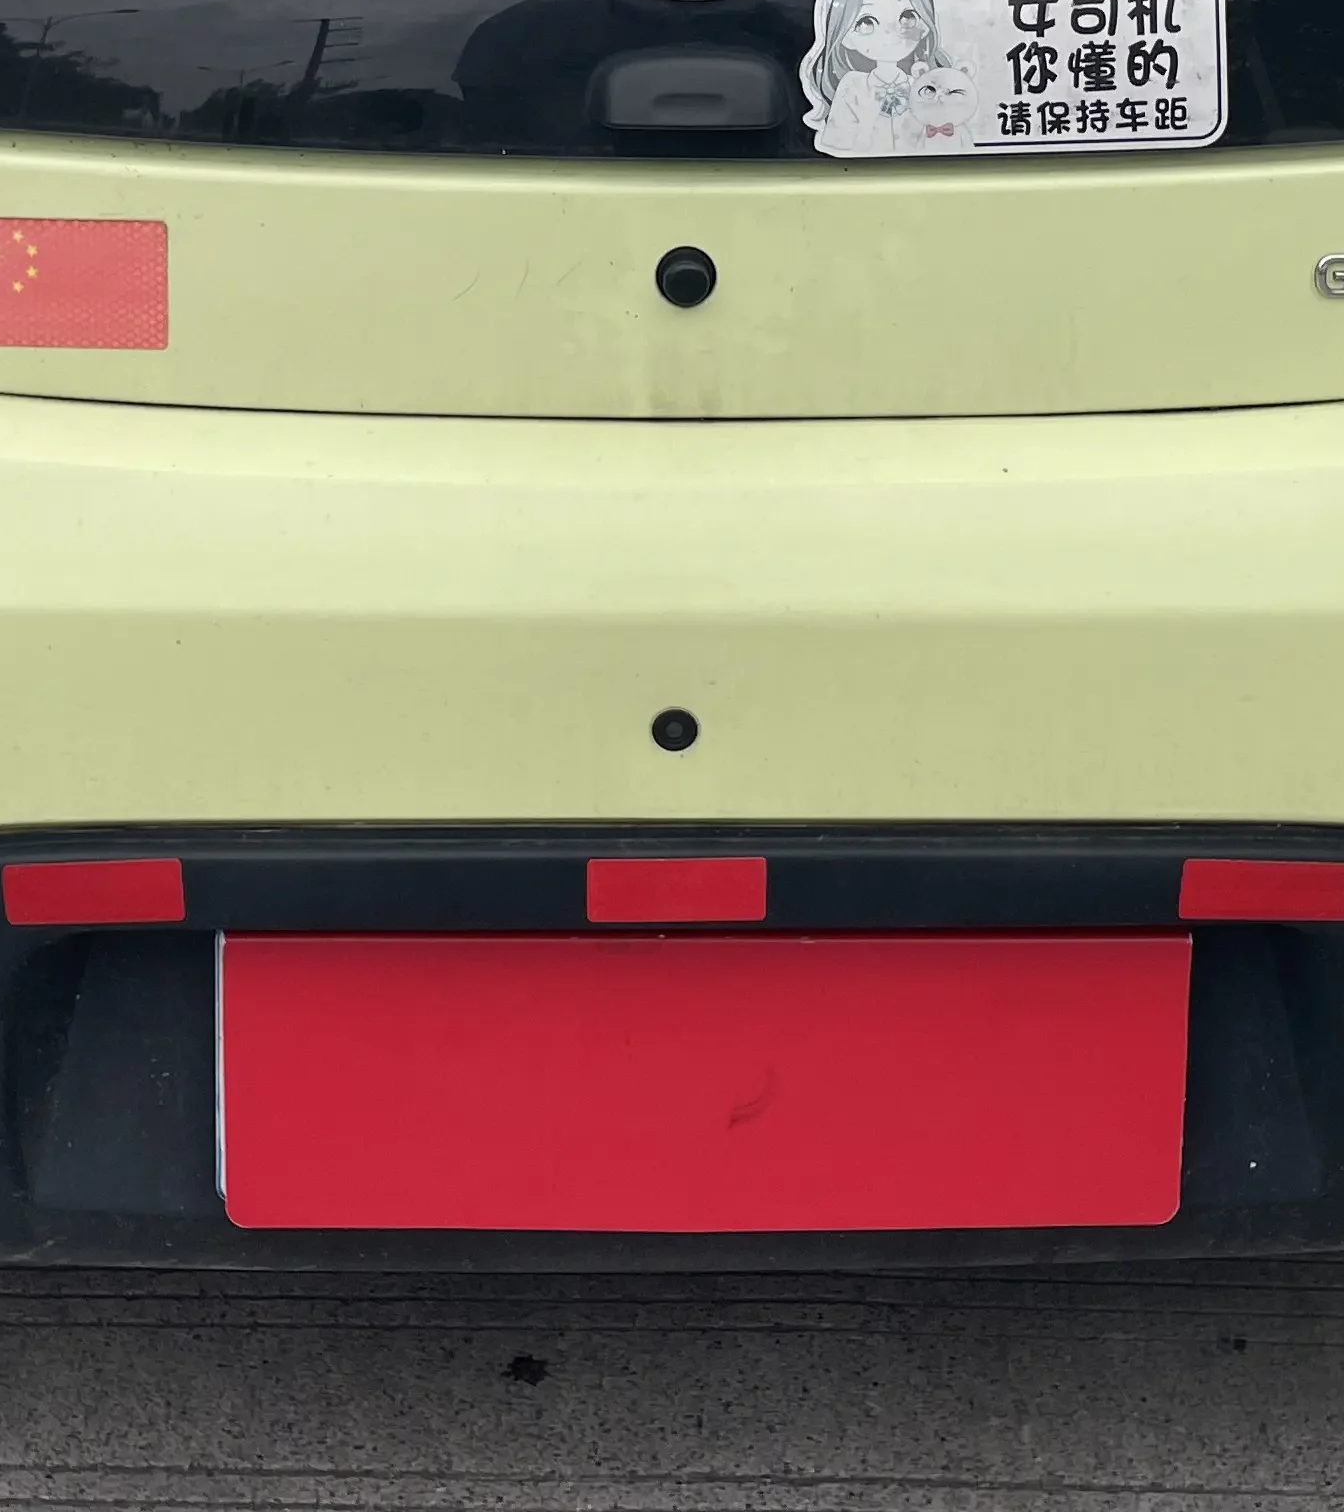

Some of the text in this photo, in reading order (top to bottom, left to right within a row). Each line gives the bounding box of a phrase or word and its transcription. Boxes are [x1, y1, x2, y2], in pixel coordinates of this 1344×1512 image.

[1006, 38, 1180, 95] 你懂的
[997, 96, 1188, 136] 请保持车距
